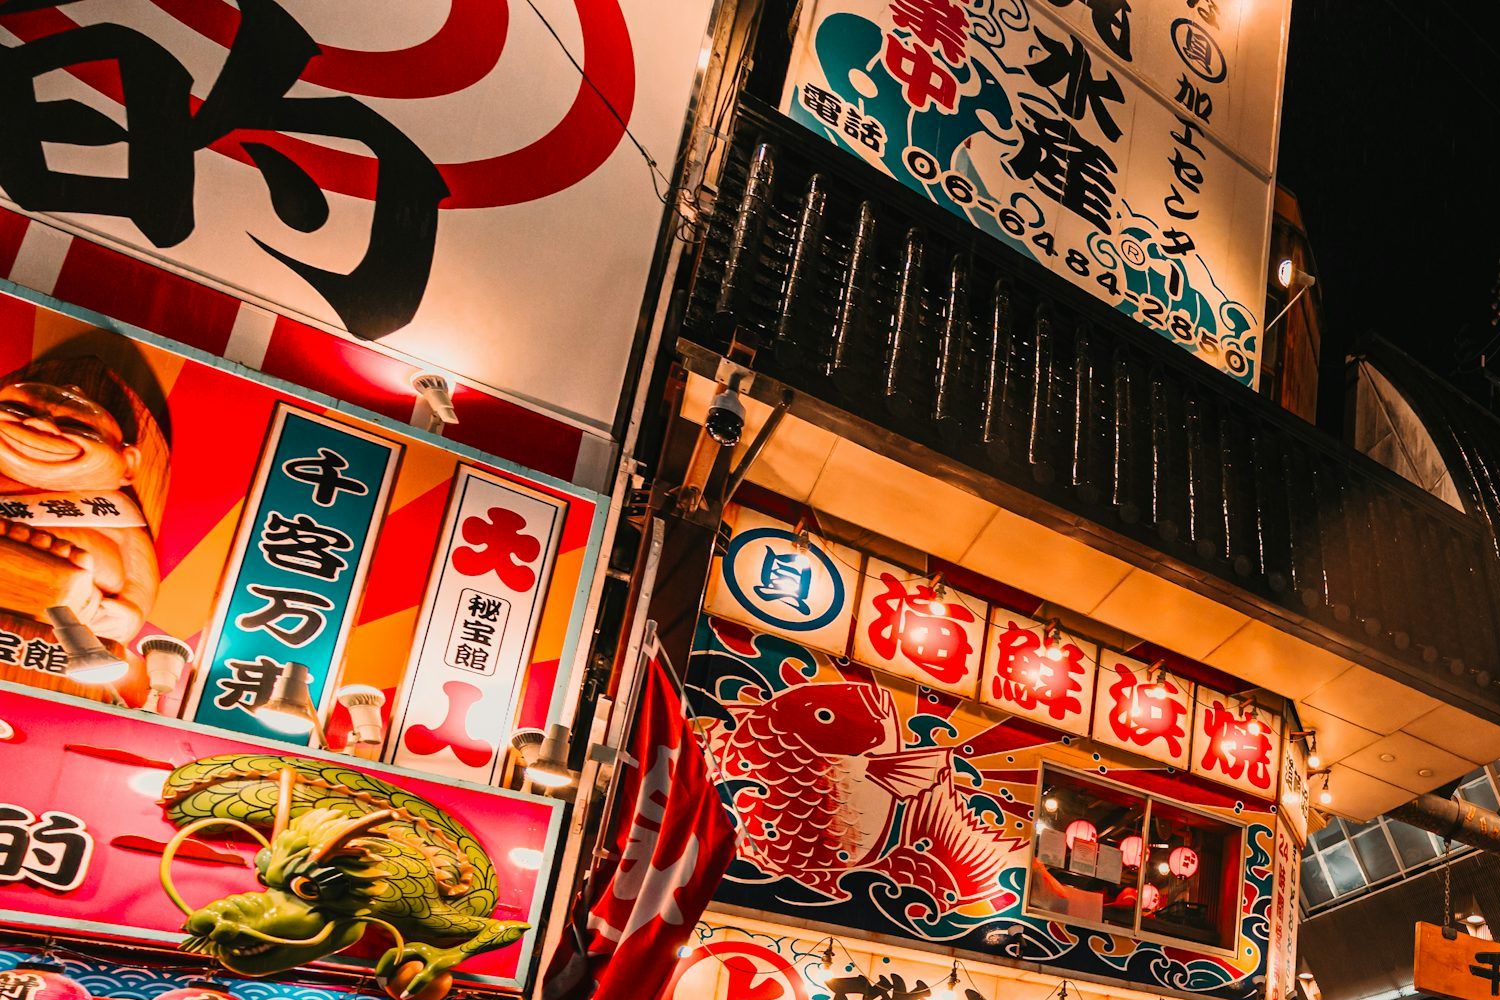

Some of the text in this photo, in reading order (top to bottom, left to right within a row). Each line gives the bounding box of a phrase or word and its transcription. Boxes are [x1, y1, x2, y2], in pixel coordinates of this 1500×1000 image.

[0, 0, 451, 341] 的
[803, 82, 886, 152] 電話
[906, 150, 1246, 376] 06-6484-2850
[453, 594, 503, 672] 秘宝館
[867, 571, 1272, 791] 海鮮浜焼
